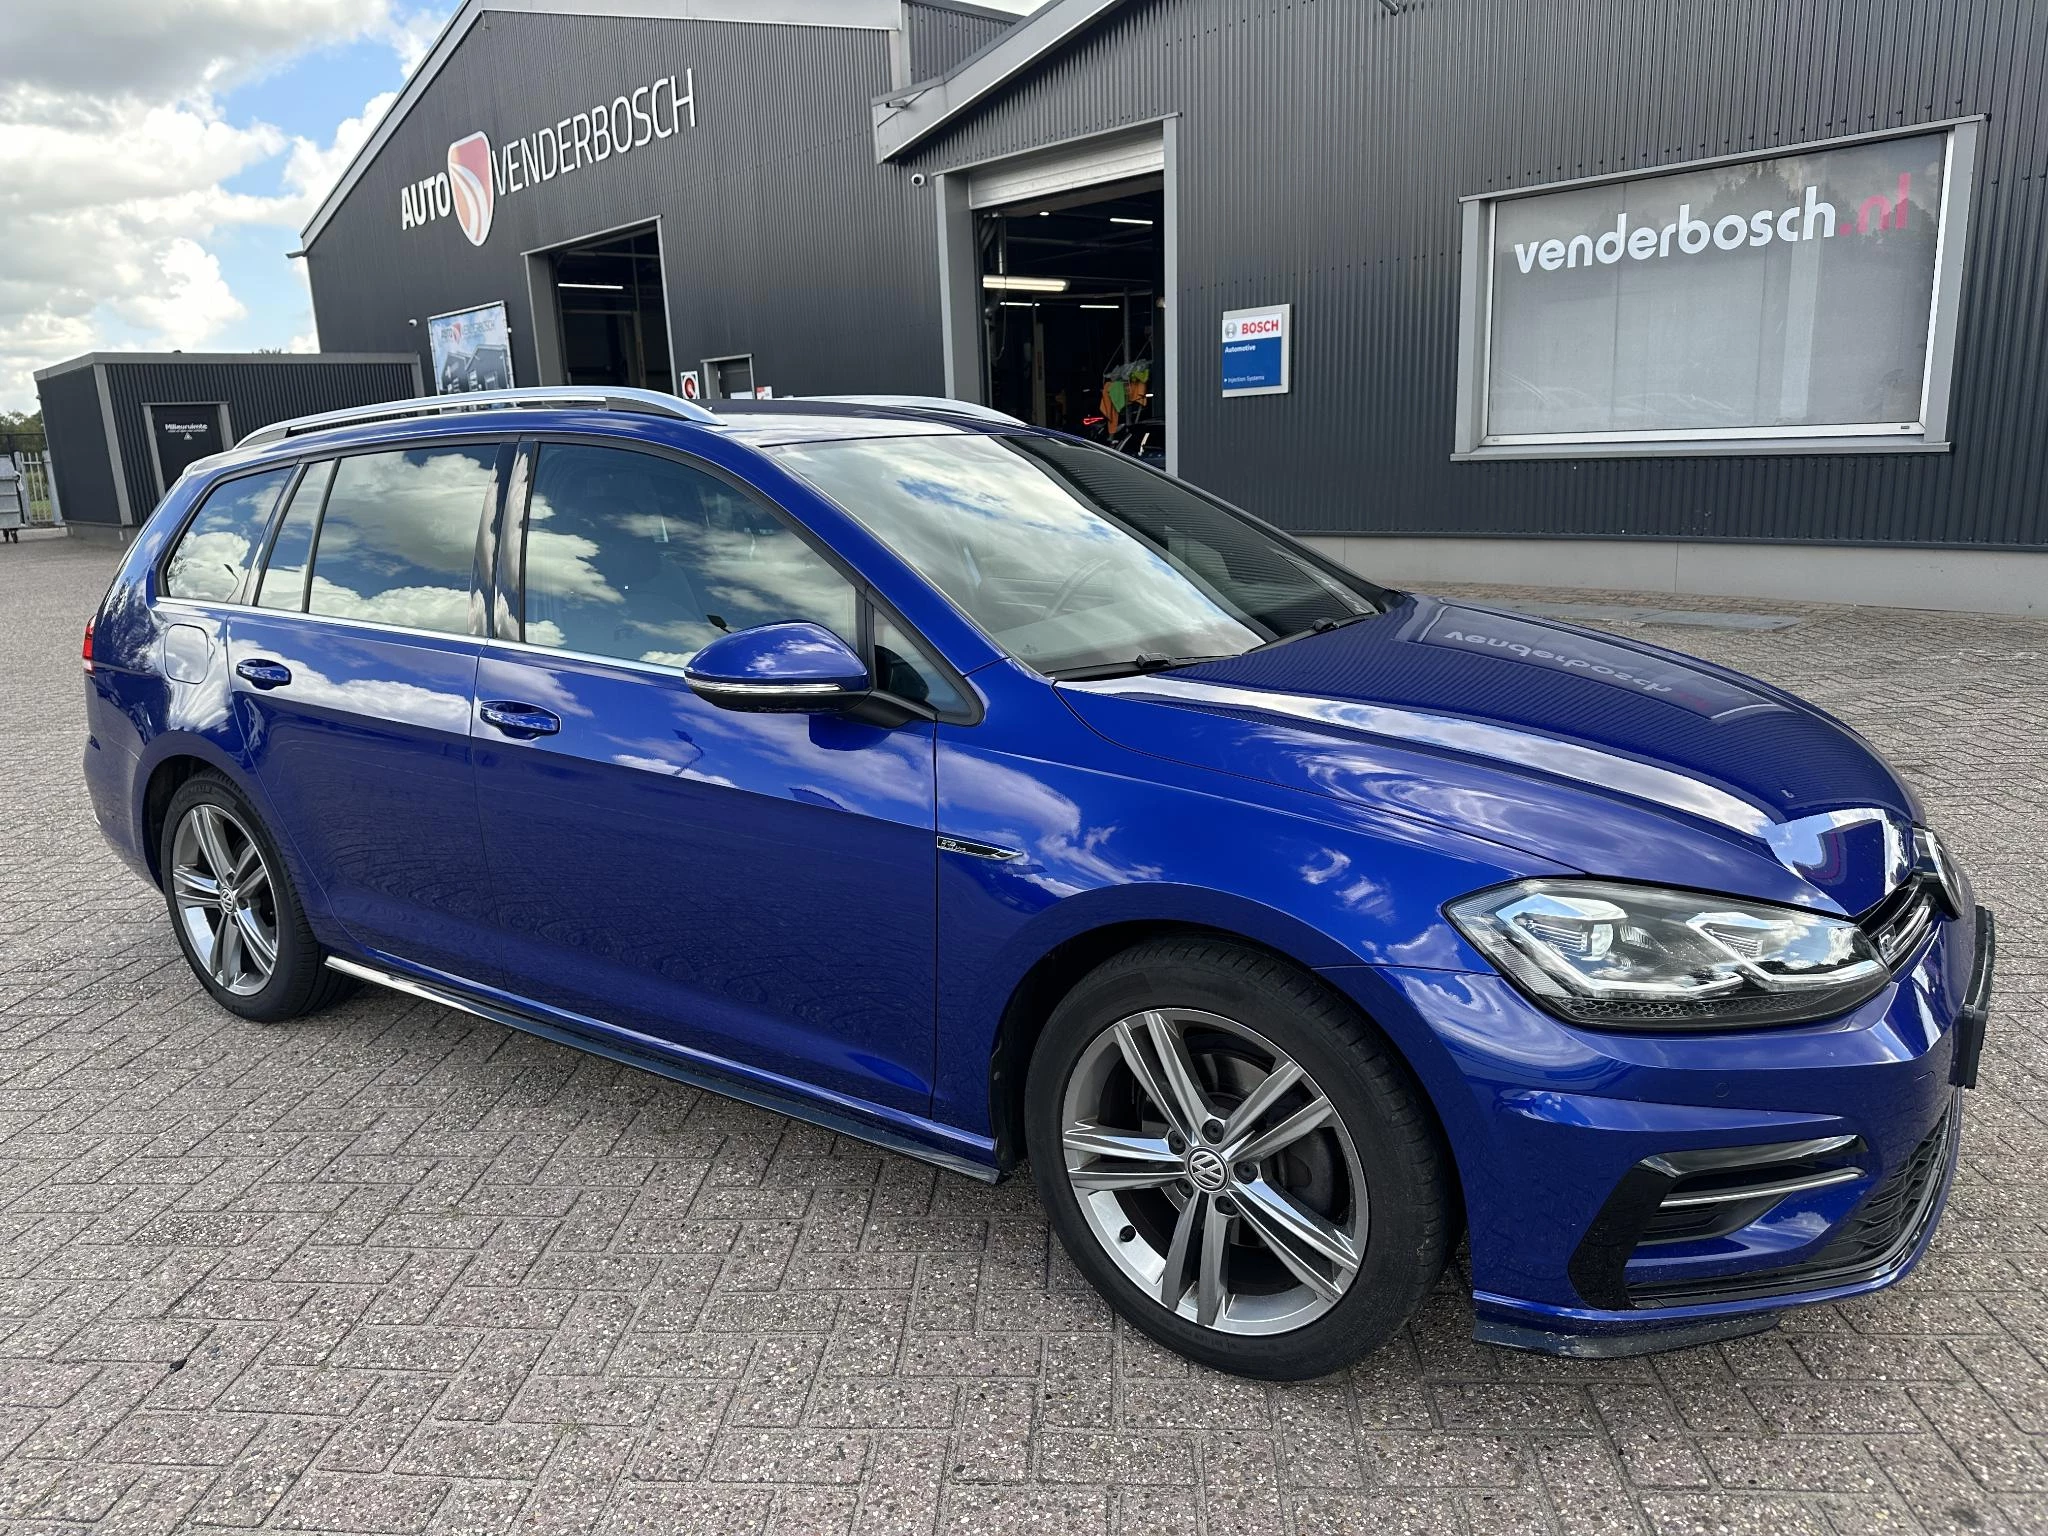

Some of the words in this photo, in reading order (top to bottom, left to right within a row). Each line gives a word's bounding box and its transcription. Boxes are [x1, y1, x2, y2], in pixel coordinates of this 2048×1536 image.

[401, 171, 451, 230] AUTO
[492, 67, 696, 196] VENDERBOSCH
[1514, 172, 1911, 274] venderbosch.nl
[1242, 319, 1279, 334] BOSCH
[1225, 343, 1256, 353] Automotive
[1228, 376, 1246, 384] Injection
[1247, 375, 1265, 383] Systems
